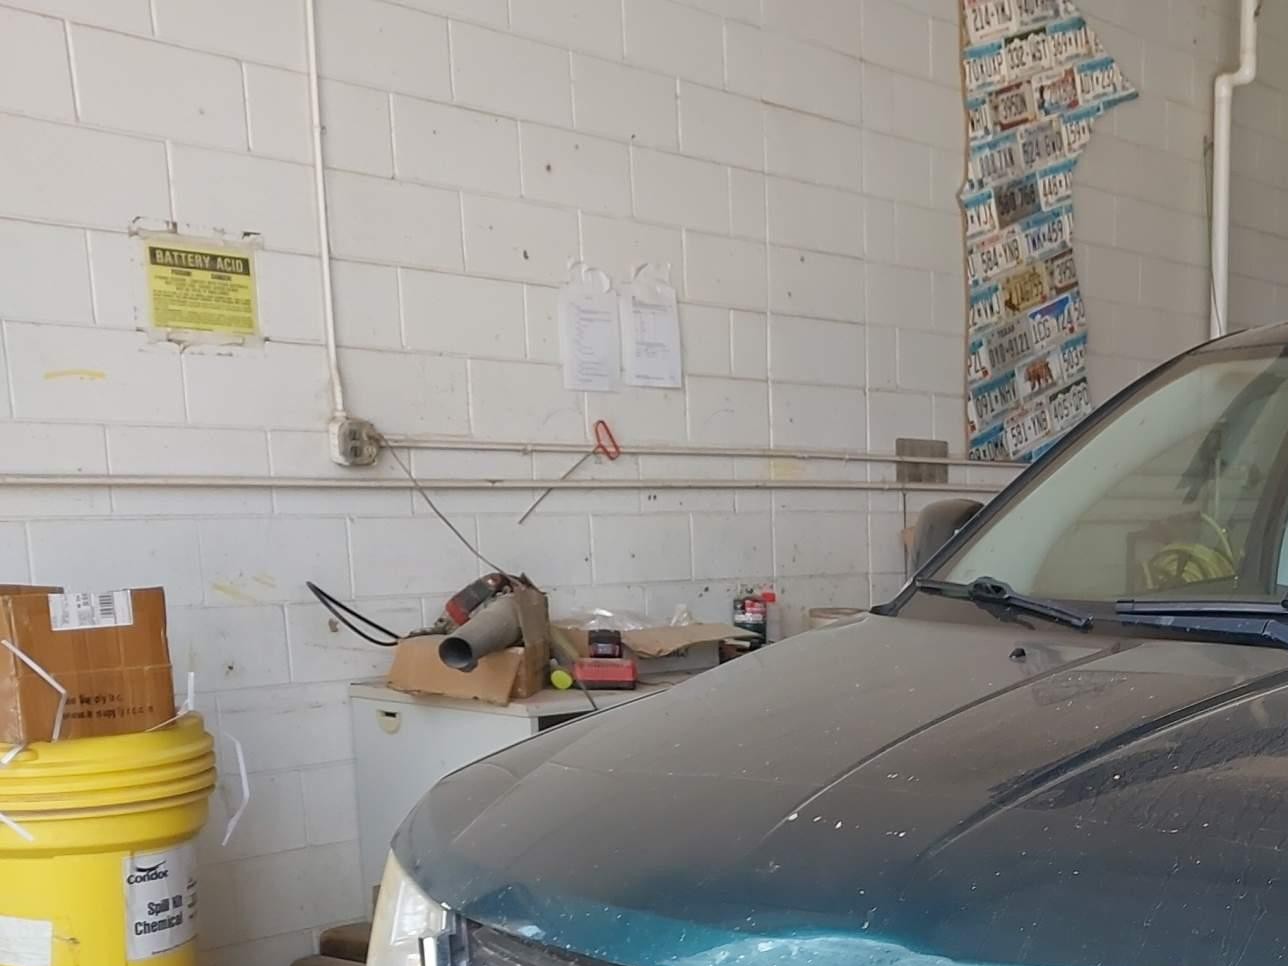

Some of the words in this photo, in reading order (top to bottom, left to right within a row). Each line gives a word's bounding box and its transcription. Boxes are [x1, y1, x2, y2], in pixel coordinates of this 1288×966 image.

[154, 249, 211, 270] BATTERY
[216, 257, 244, 273] ACID
[126, 868, 169, 886] Condor
[147, 897, 170, 917] Spill
[134, 911, 183, 936] Chemical
